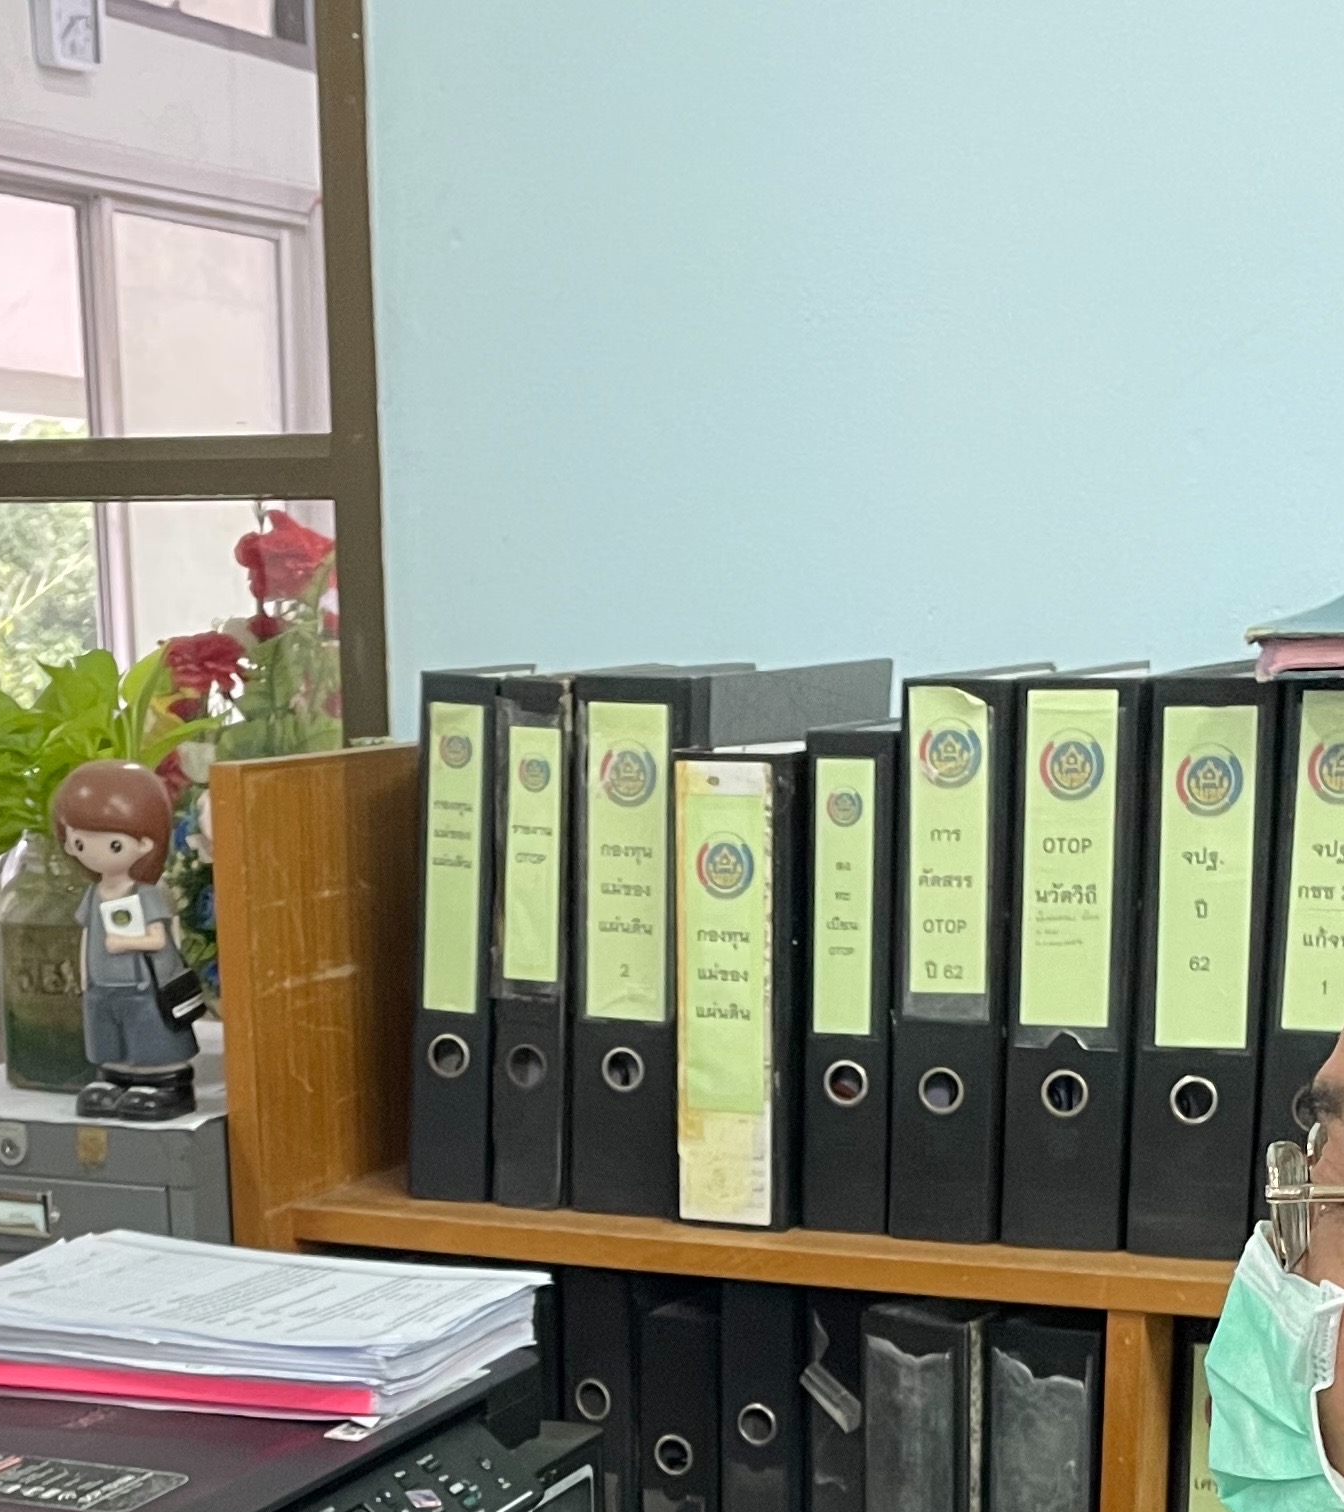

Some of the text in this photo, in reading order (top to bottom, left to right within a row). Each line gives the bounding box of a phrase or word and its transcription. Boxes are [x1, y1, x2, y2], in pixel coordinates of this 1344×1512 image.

[930, 828, 961, 842] การ
[1042, 837, 1092, 854] OTOP
[919, 868, 972, 888] คัดสรร
[1035, 882, 1097, 904] นวัตวิถี
[1194, 898, 1207, 919] ปี
[922, 919, 967, 934] OTOP
[697, 929, 750, 949] กองทุน
[619, 964, 629, 977] 2
[697, 963, 748, 982] แม่ของ
[925, 960, 963, 980] ปี 62
[1189, 955, 1210, 972] 62
